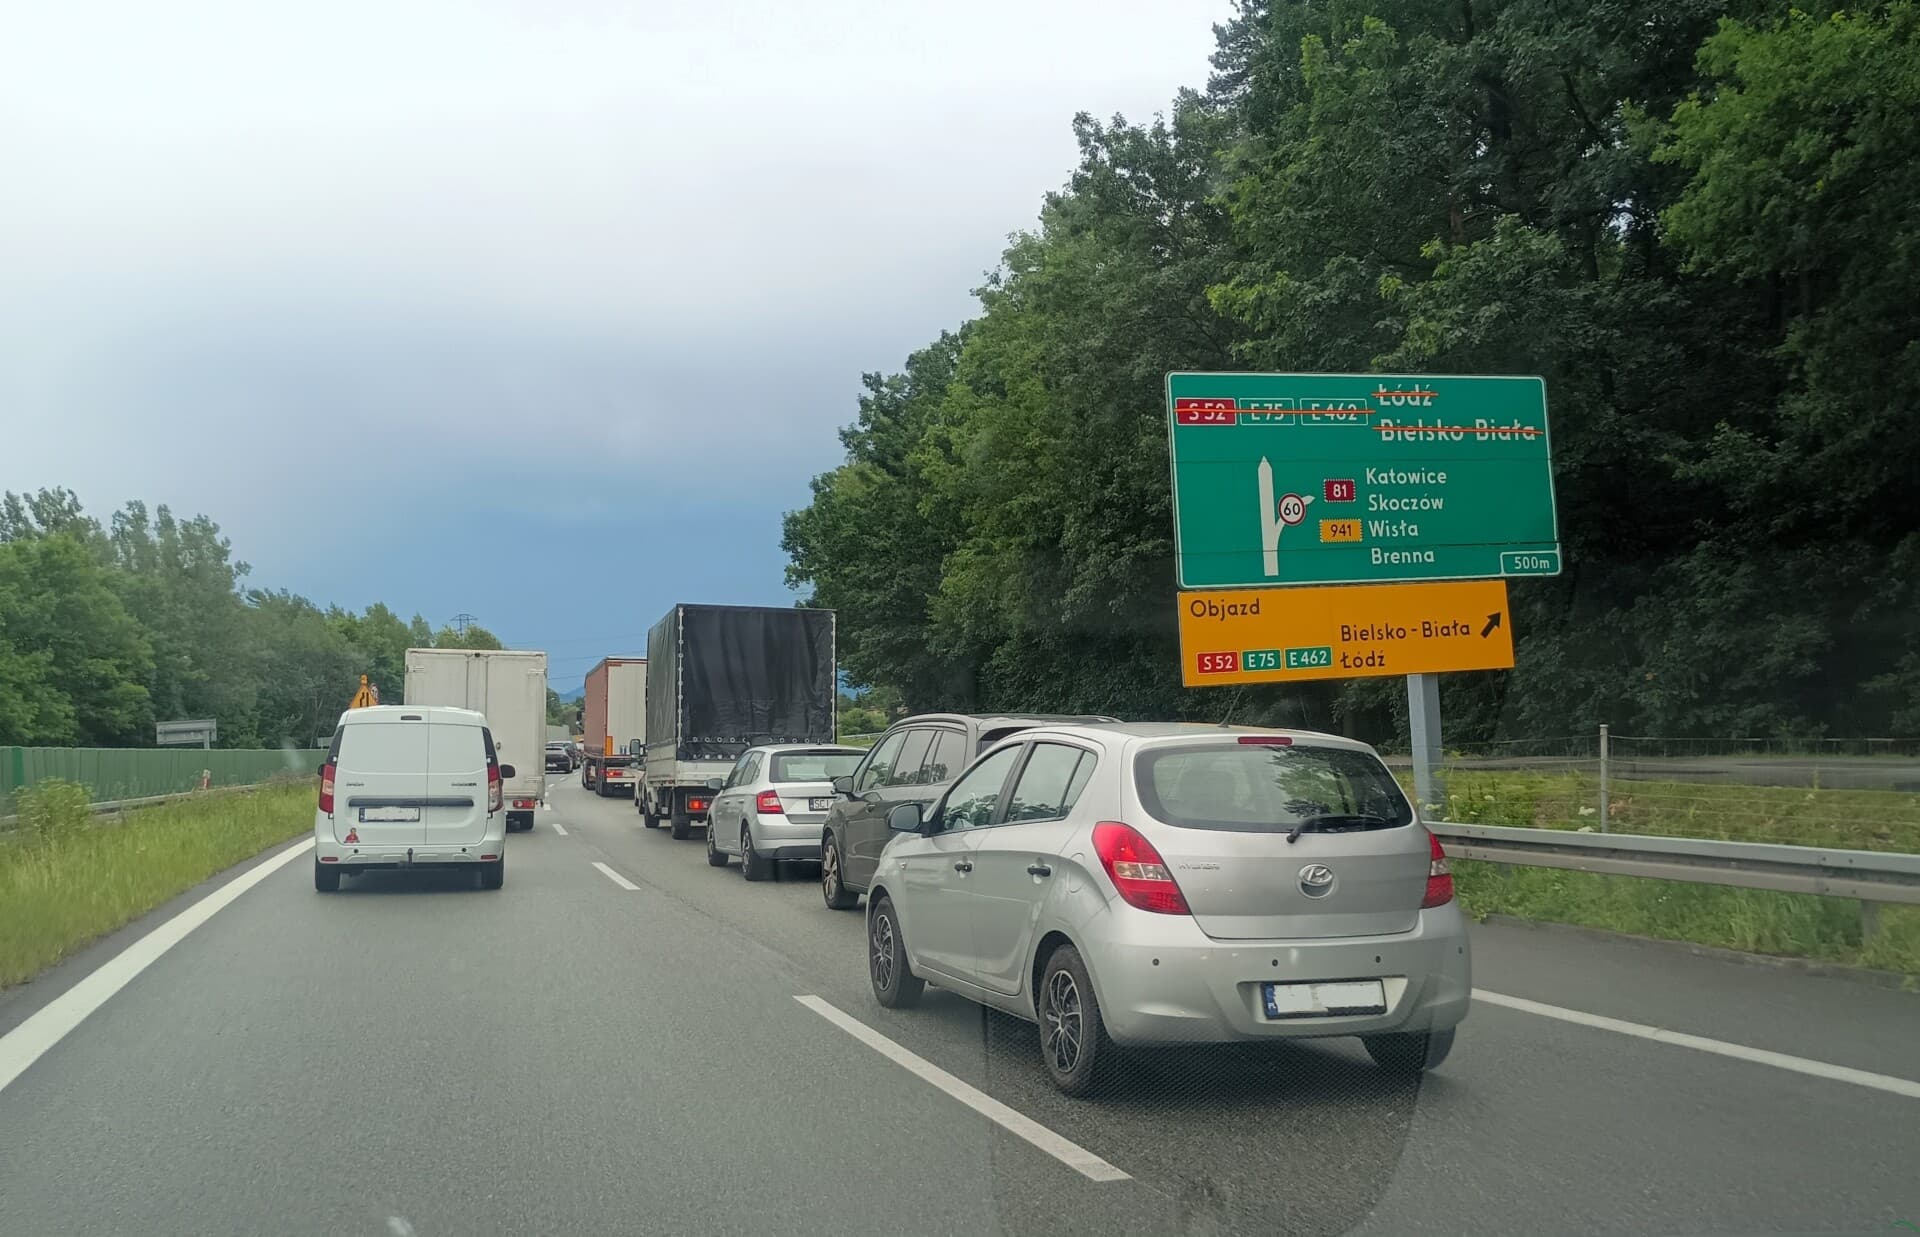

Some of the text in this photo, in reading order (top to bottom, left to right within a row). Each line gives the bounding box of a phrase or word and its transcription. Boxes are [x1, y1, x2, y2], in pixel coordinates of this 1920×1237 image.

[1366, 467, 1447, 485] Katowice
[1332, 484, 1348, 498] 81
[1283, 502, 1301, 516] 60
[1368, 493, 1444, 511] Skoczów
[1330, 524, 1352, 537] 941
[1368, 520, 1419, 537] Wisła
[1371, 547, 1435, 565] Brenna
[1514, 556, 1550, 570] 500m
[1190, 598, 1260, 621] Objazd
[1340, 650, 1385, 669] Łódź
